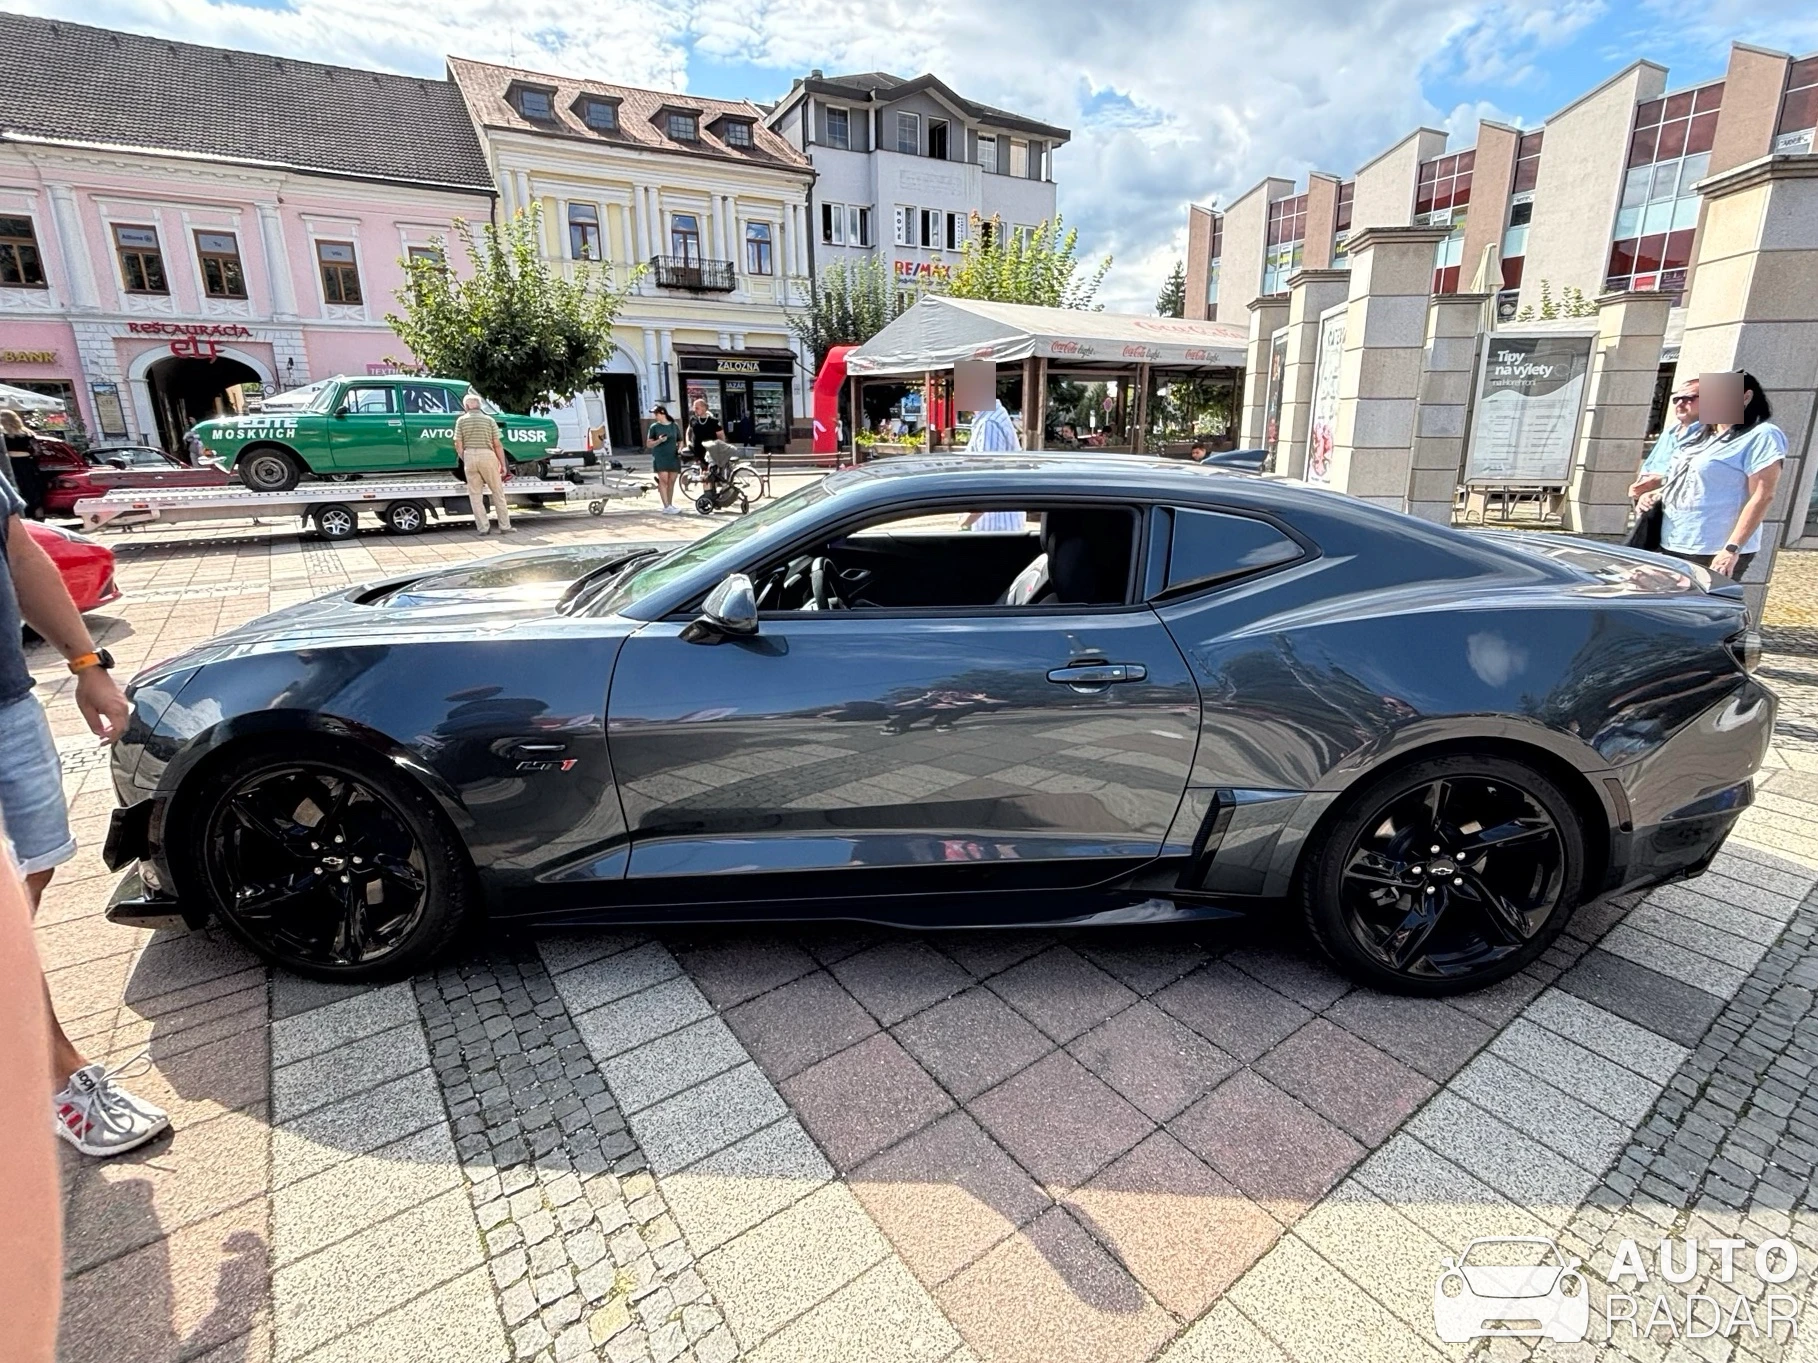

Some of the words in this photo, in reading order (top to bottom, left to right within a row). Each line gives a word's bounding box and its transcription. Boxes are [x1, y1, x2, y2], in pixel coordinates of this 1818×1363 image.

[1497, 350, 1525, 366] Tipy
[1495, 365, 1512, 375] na
[1513, 362, 1554, 378] výlety
[212, 428, 296, 440] MOSKVICH
[507, 429, 548, 443] USSR
